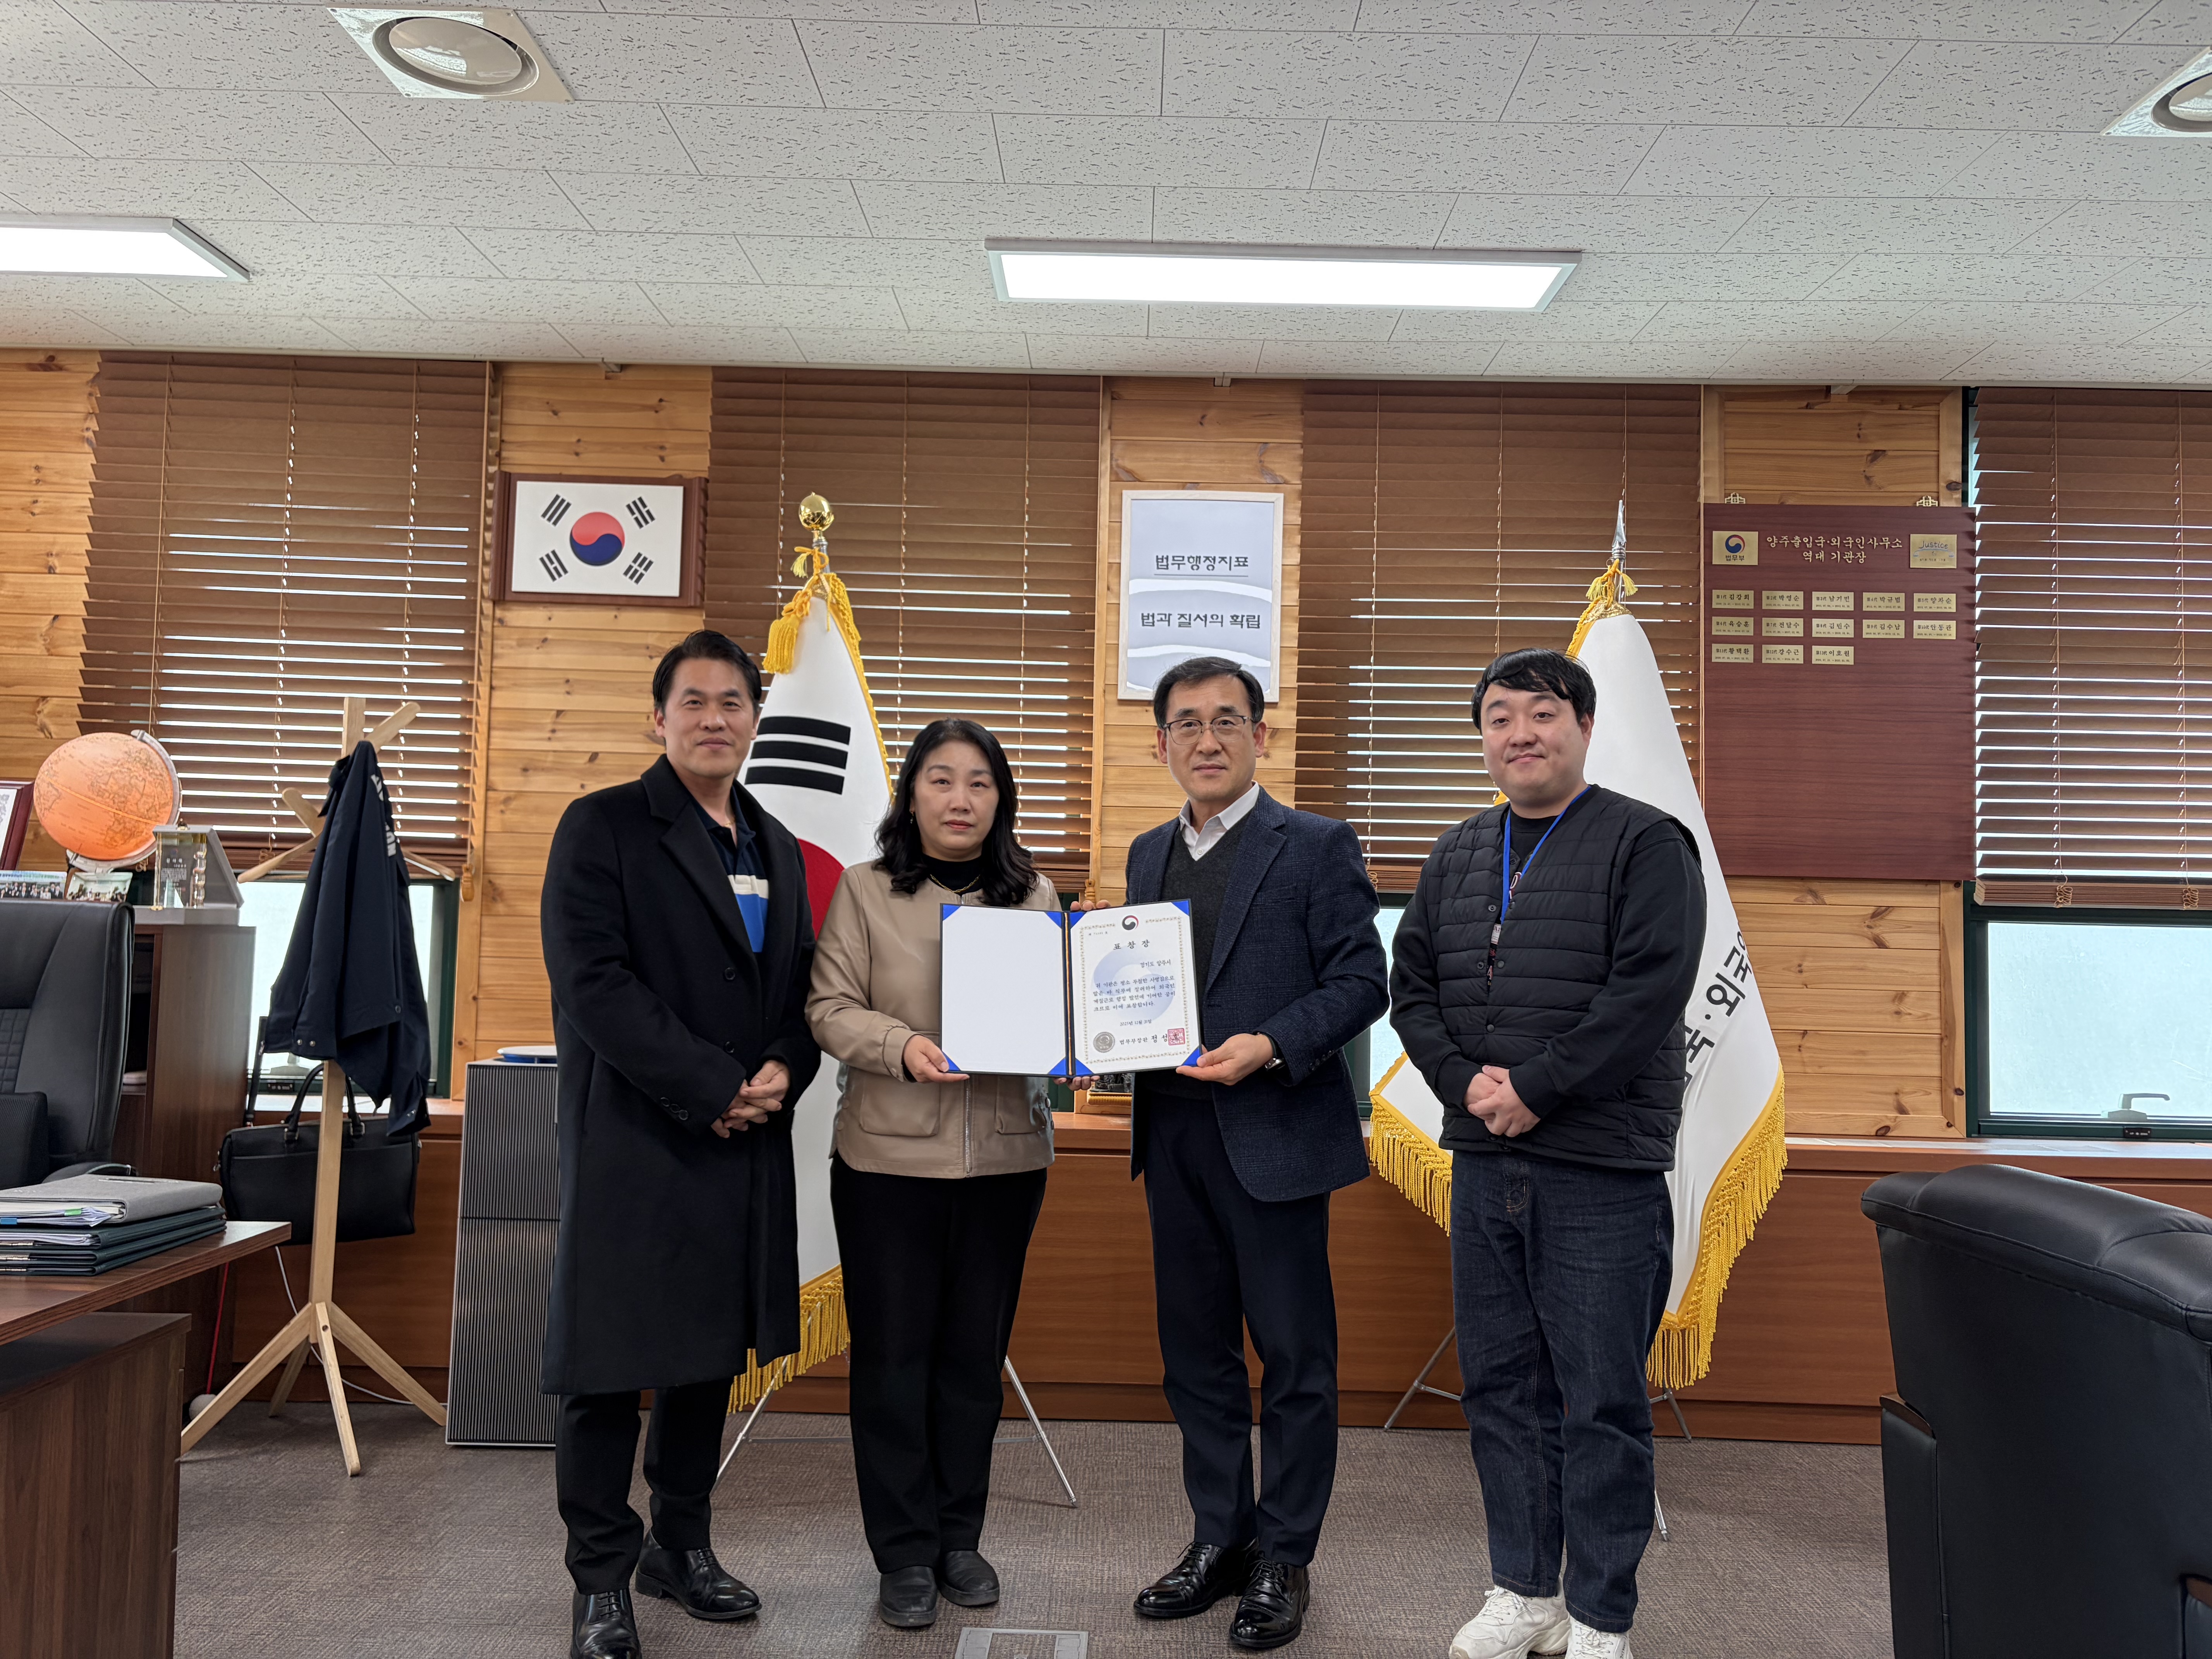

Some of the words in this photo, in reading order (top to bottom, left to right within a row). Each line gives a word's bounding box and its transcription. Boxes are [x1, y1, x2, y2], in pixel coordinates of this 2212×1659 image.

[1767, 535, 1903, 549] 양주출입국·외국인사무소
[1918, 541, 1948, 549] Justice
[1156, 555, 1249, 571] 법무행정지표
[1803, 551, 1824, 563] 역대
[1831, 551, 1867, 563] 기관장
[1141, 613, 1172, 627] 법과
[1177, 613, 1224, 628] 질서의
[1230, 614, 1261, 629] 확립
[1120, 1037, 1149, 1045] 법무부장관
